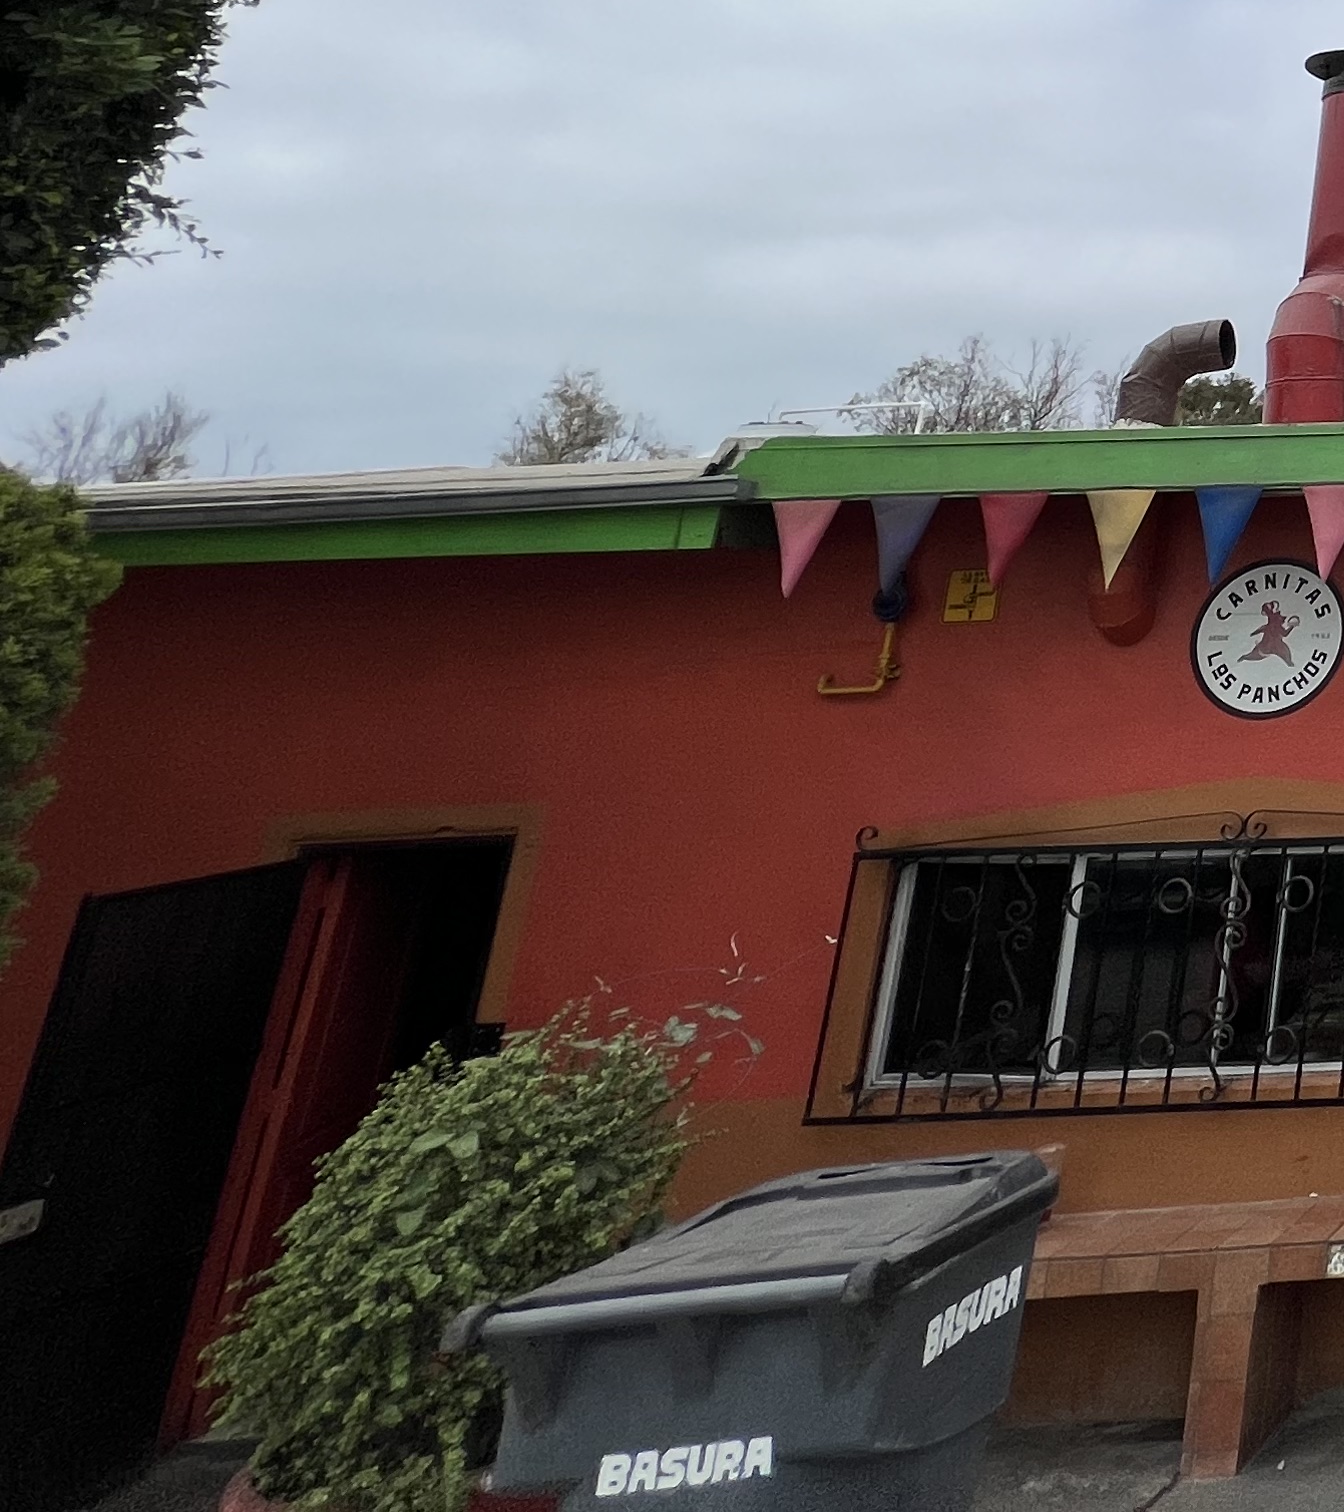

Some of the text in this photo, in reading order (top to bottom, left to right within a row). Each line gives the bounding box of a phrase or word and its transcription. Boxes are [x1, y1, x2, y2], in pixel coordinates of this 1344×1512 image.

[1216, 572, 1332, 621] CARNITAS
[1236, 648, 1328, 704] PANCHOS
[922, 1264, 1024, 1369] BASURA
[595, 1435, 773, 1497] BASURA
